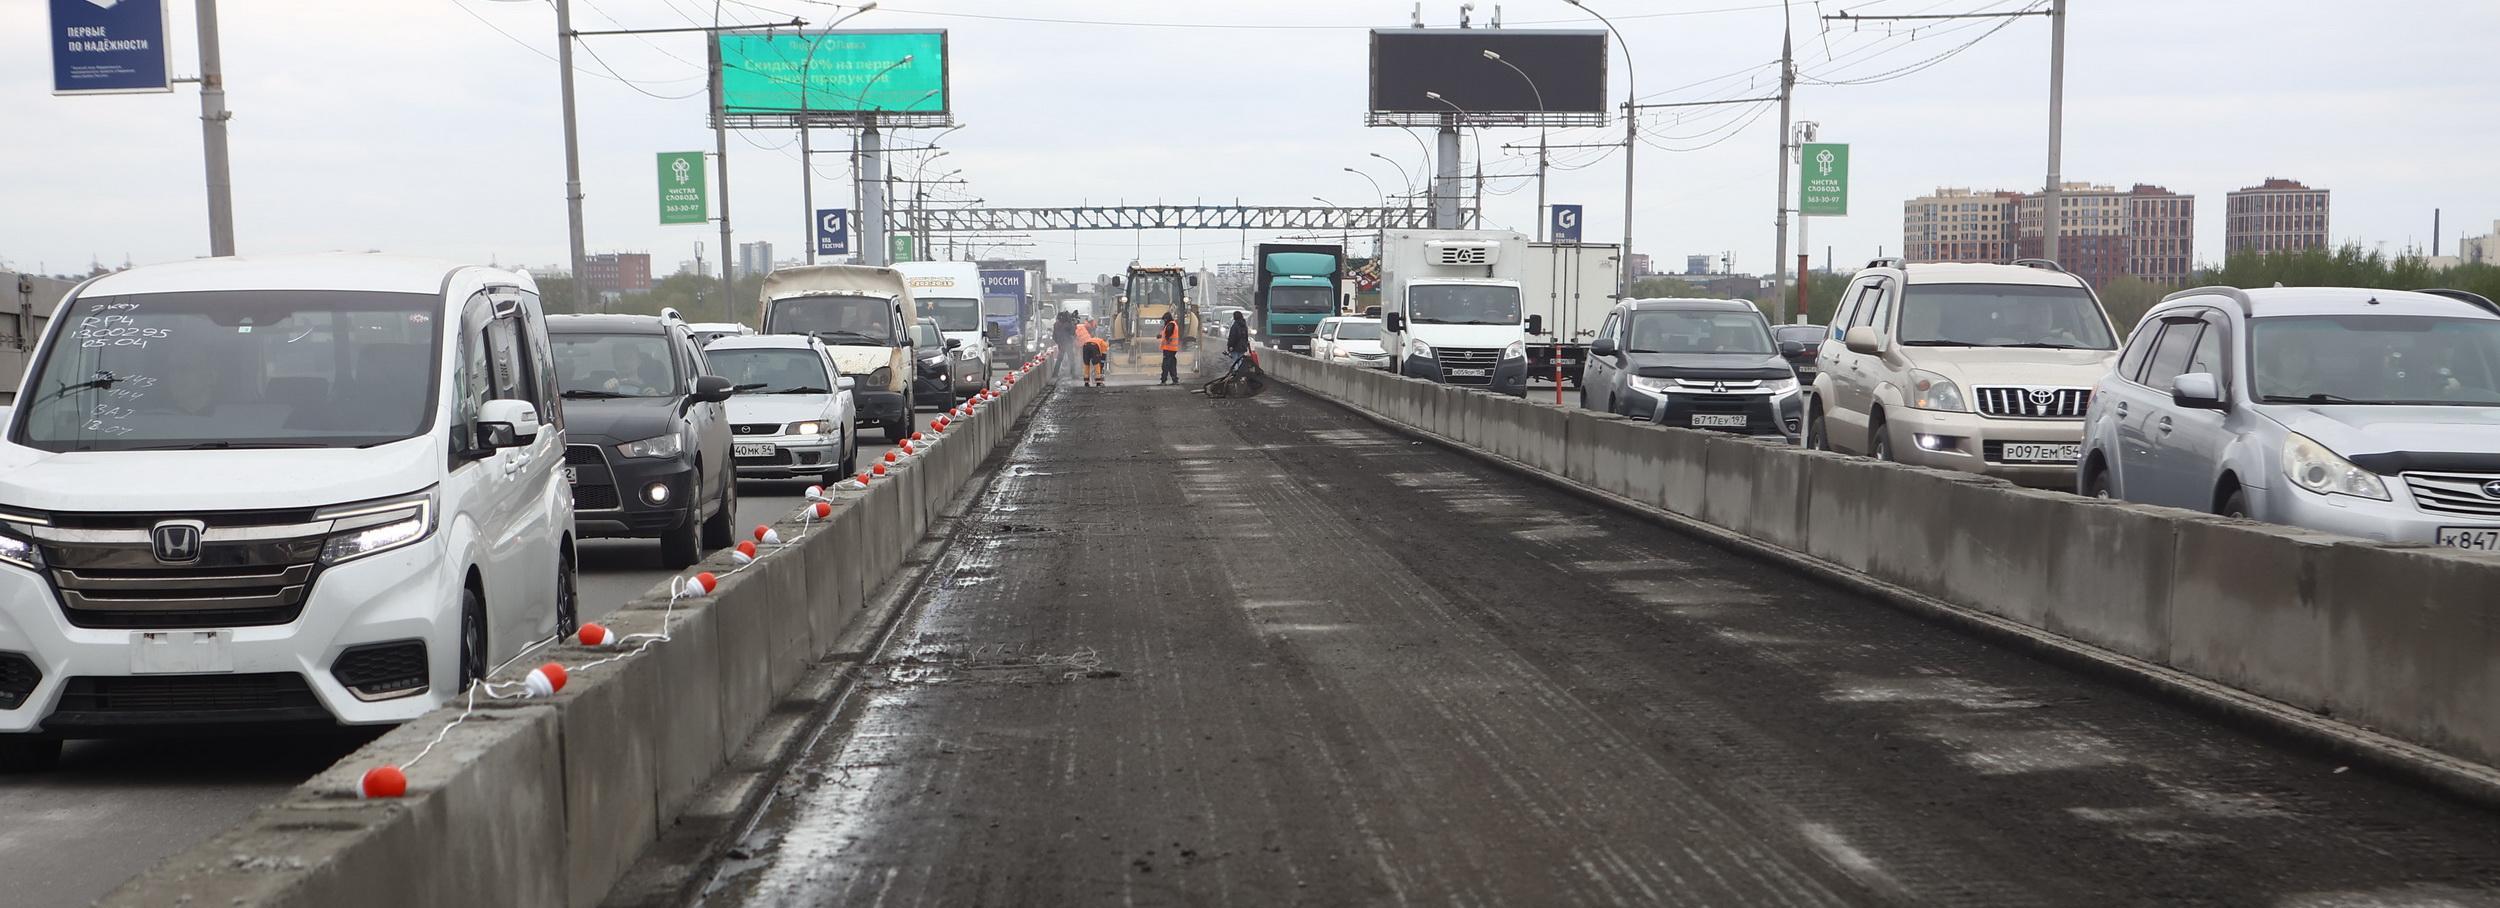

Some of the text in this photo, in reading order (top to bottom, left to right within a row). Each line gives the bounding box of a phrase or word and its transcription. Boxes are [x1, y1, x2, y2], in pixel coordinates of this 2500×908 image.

[67, 26, 107, 37] ПЕРВЫЕ
[68, 39, 148, 52] ПО НАДЁЖНОСТИ
[745, 60, 799, 71] Скидка
[836, 61, 852, 69] на
[988, 277, 1019, 286] РОССИИ
[1731, 415, 1744, 423] 197
[761, 444, 772, 453] 54
[2007, 445, 2079, 459] Р097ЕМ 154
[2446, 531, 2499, 550] К847
